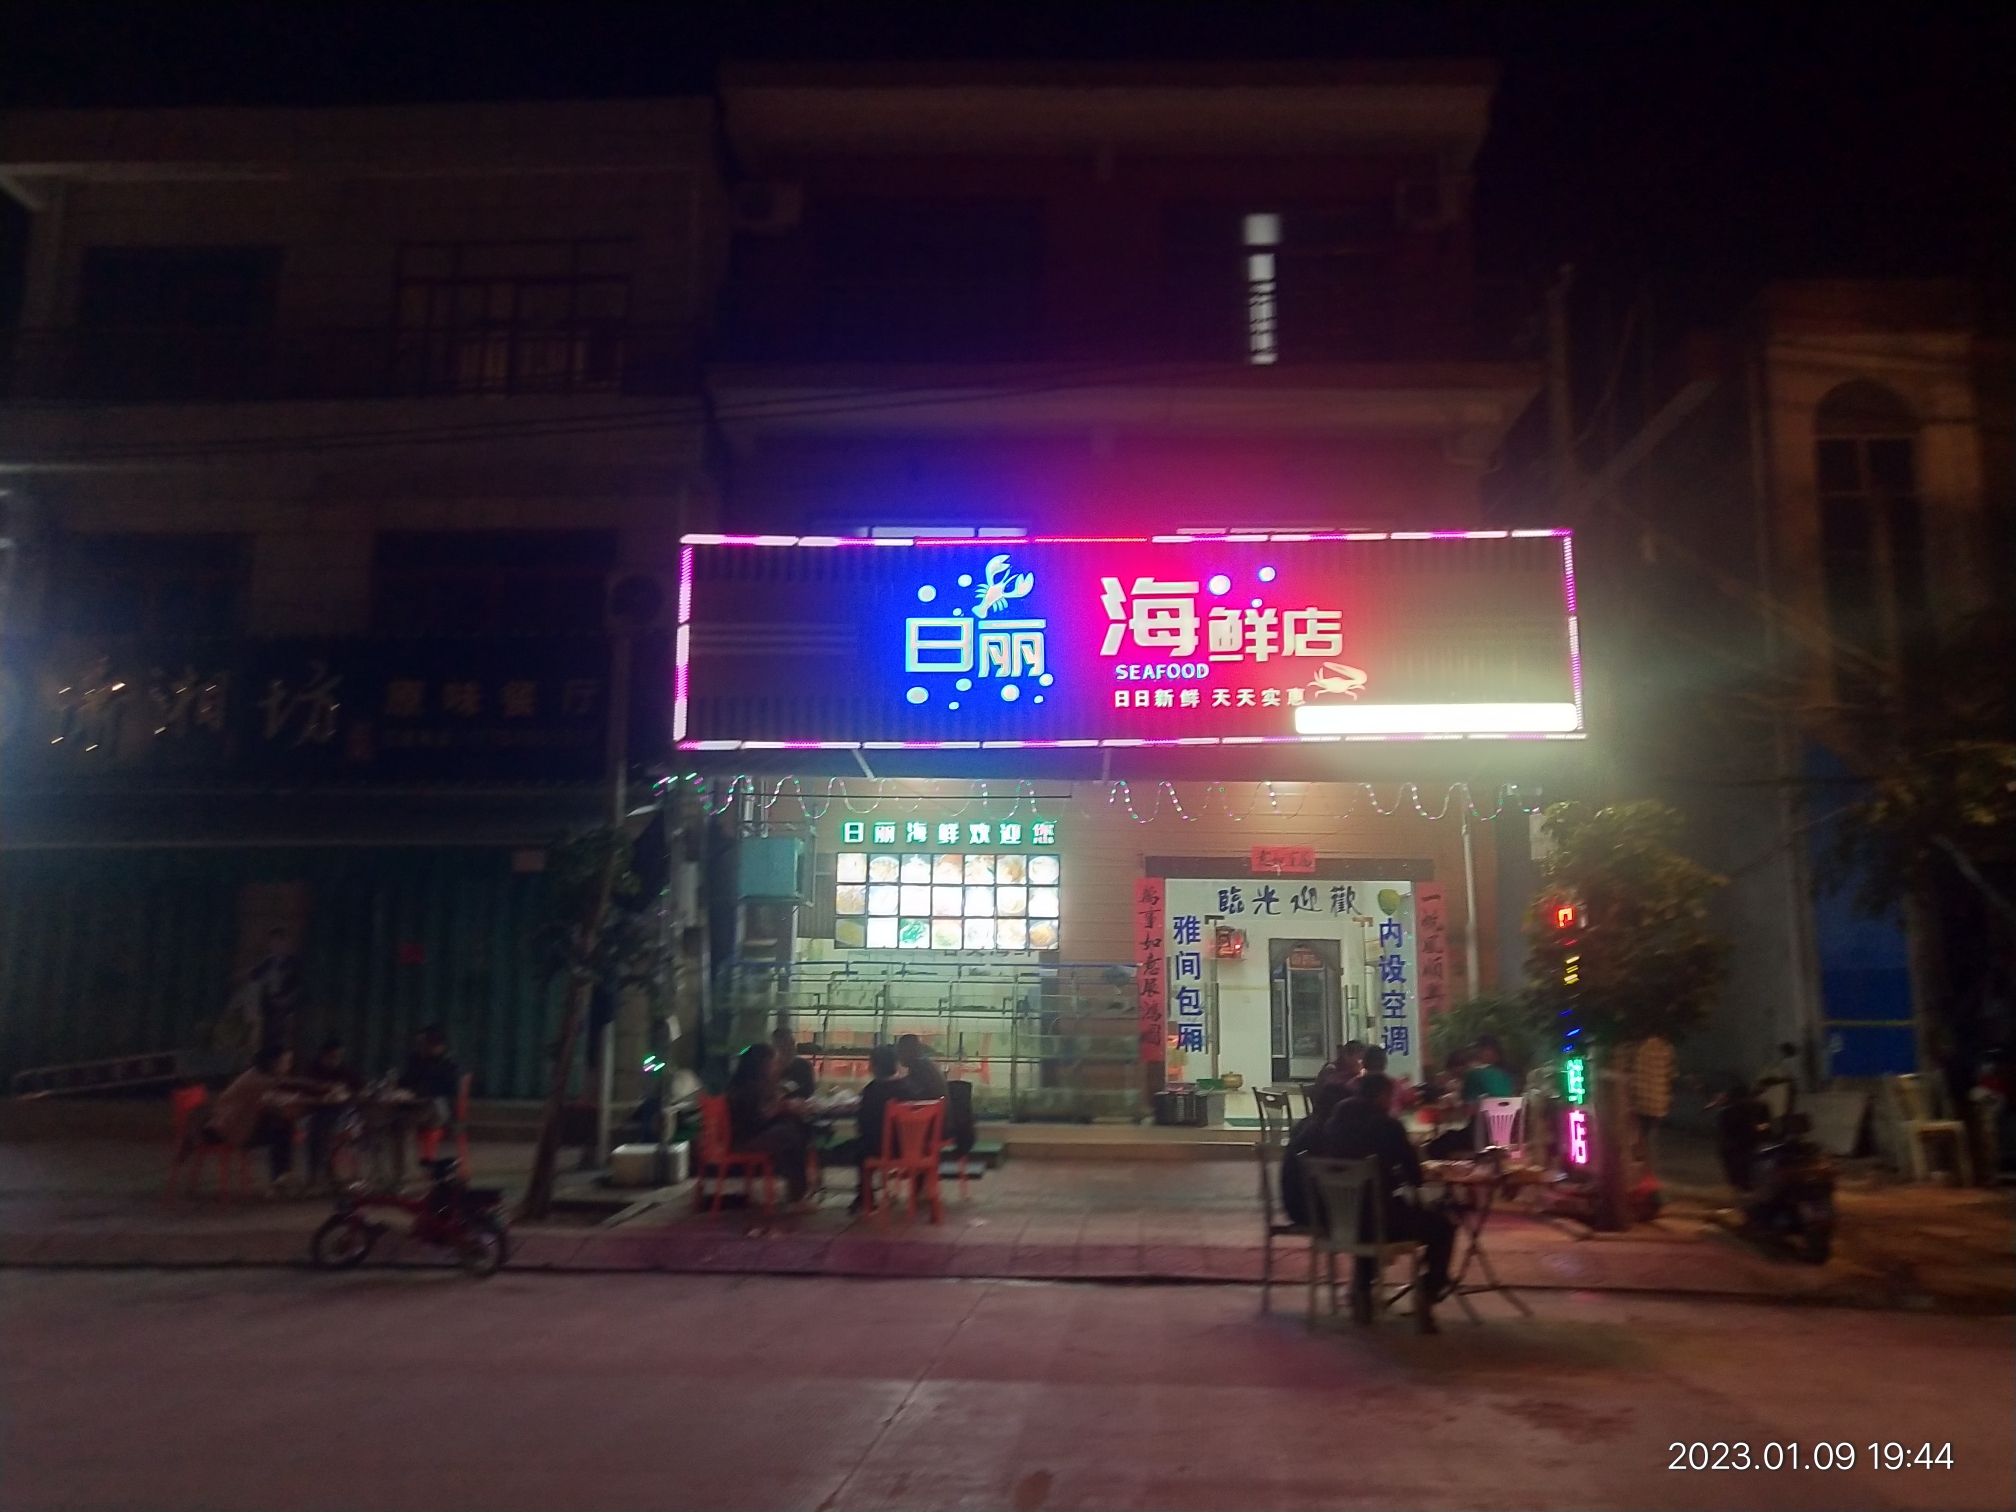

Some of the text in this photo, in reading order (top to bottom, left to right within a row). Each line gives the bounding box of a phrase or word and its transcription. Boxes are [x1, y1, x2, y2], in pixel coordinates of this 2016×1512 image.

[905, 617, 1047, 678] 日丽
[1100, 576, 1343, 662] 海鲜店
[1114, 687, 1306, 708] 日日新鲜 天天实惠
[1115, 663, 1210, 680] SEAFOOD
[843, 821, 1055, 844] 日丽海鲜欢迎您
[1173, 915, 1204, 1053] 雅间包厢
[1378, 918, 1409, 1056] 内设空调
